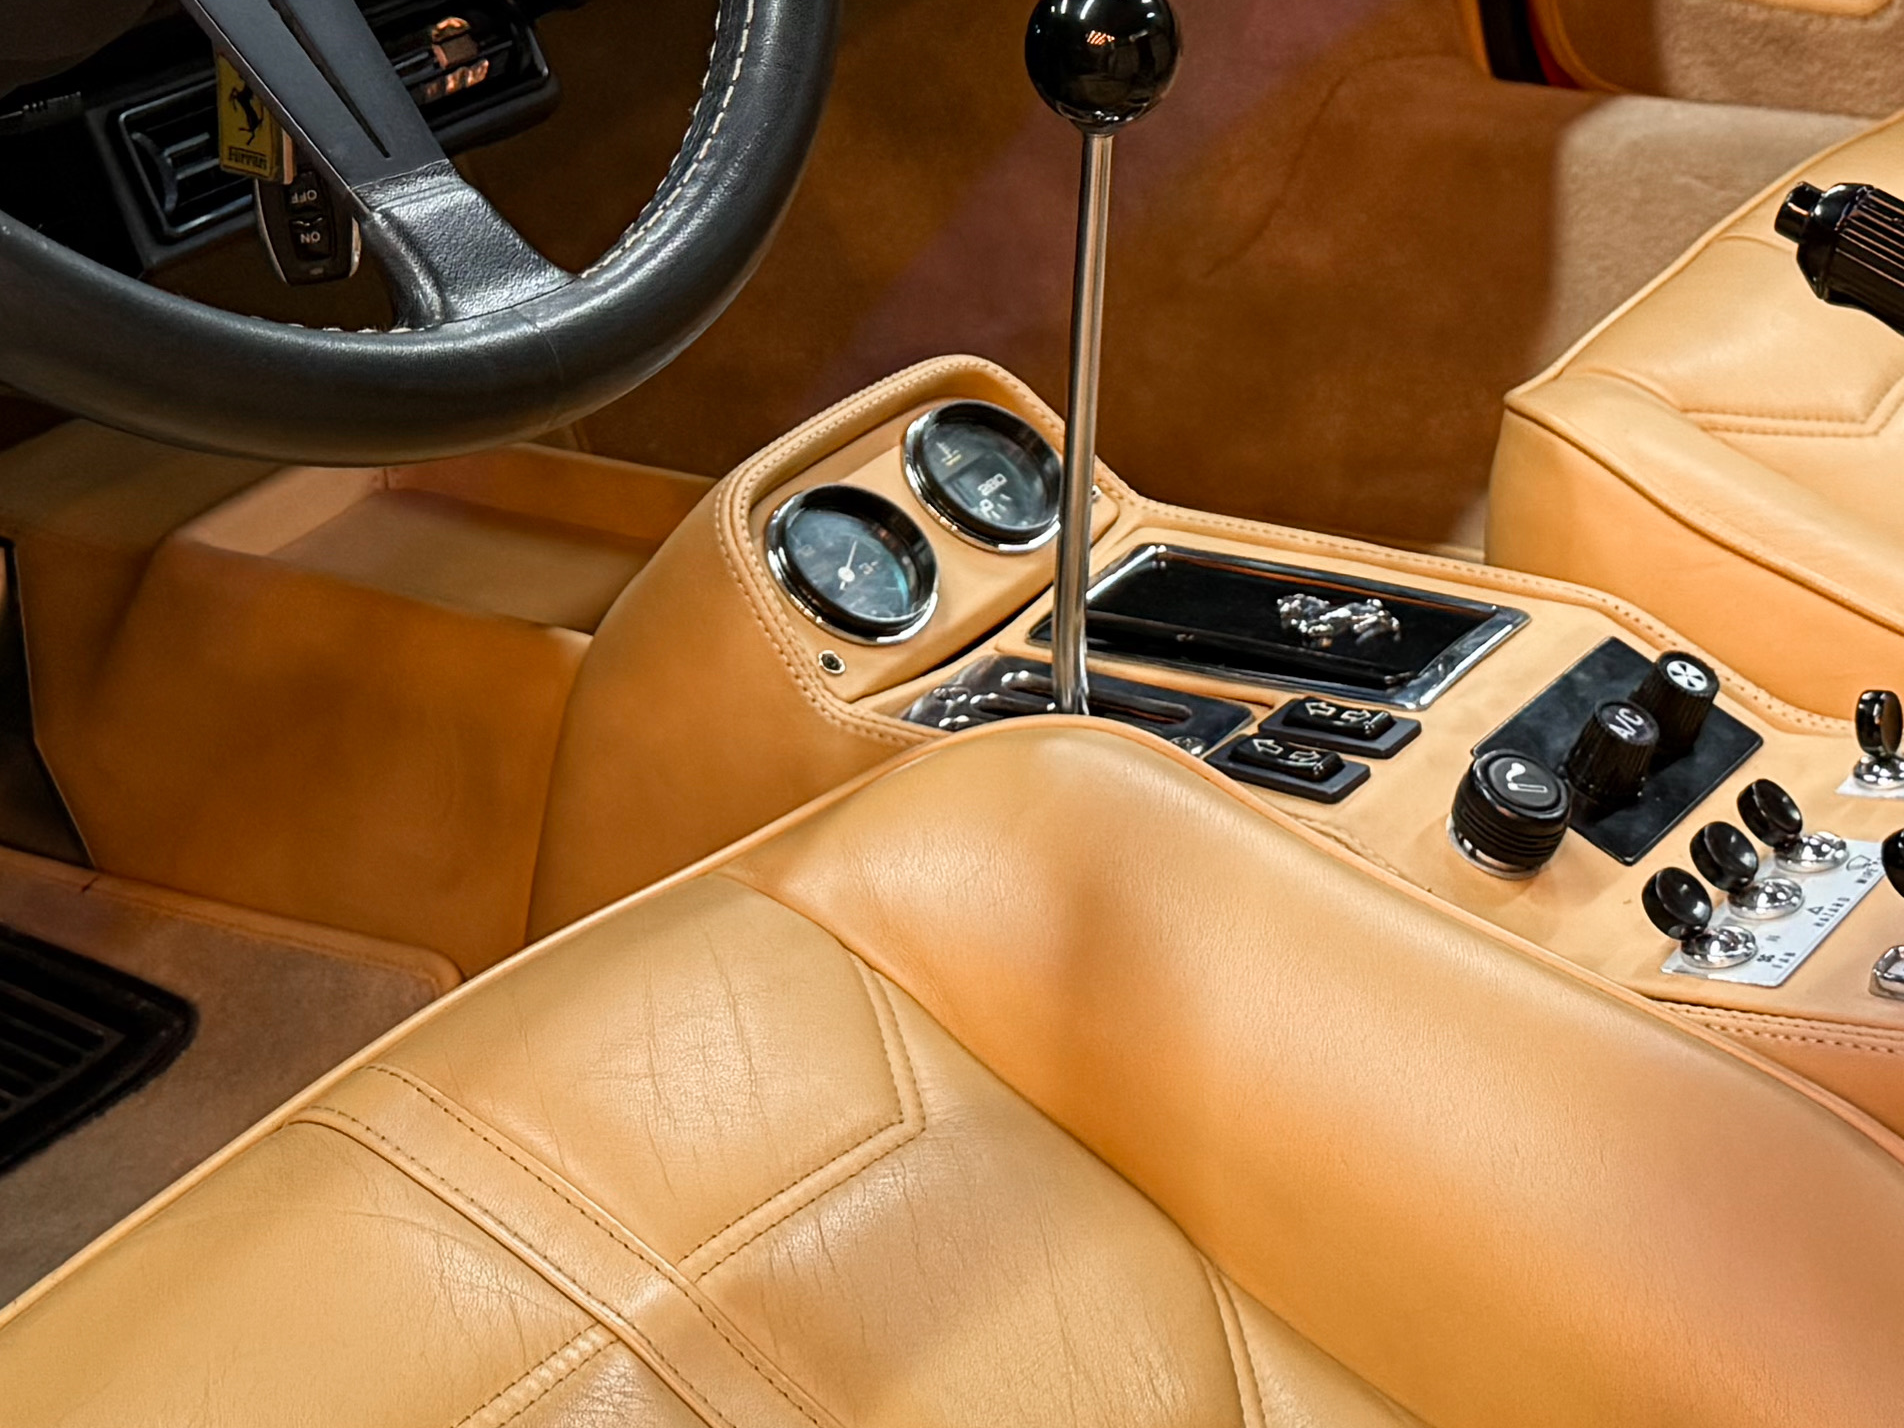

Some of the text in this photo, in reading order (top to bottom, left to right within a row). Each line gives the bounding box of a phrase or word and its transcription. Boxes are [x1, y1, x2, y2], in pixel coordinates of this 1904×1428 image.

[291, 189, 318, 204] OFF
[299, 230, 321, 244] ON
[977, 472, 1009, 497] 280
[1607, 707, 1645, 740] A/C
